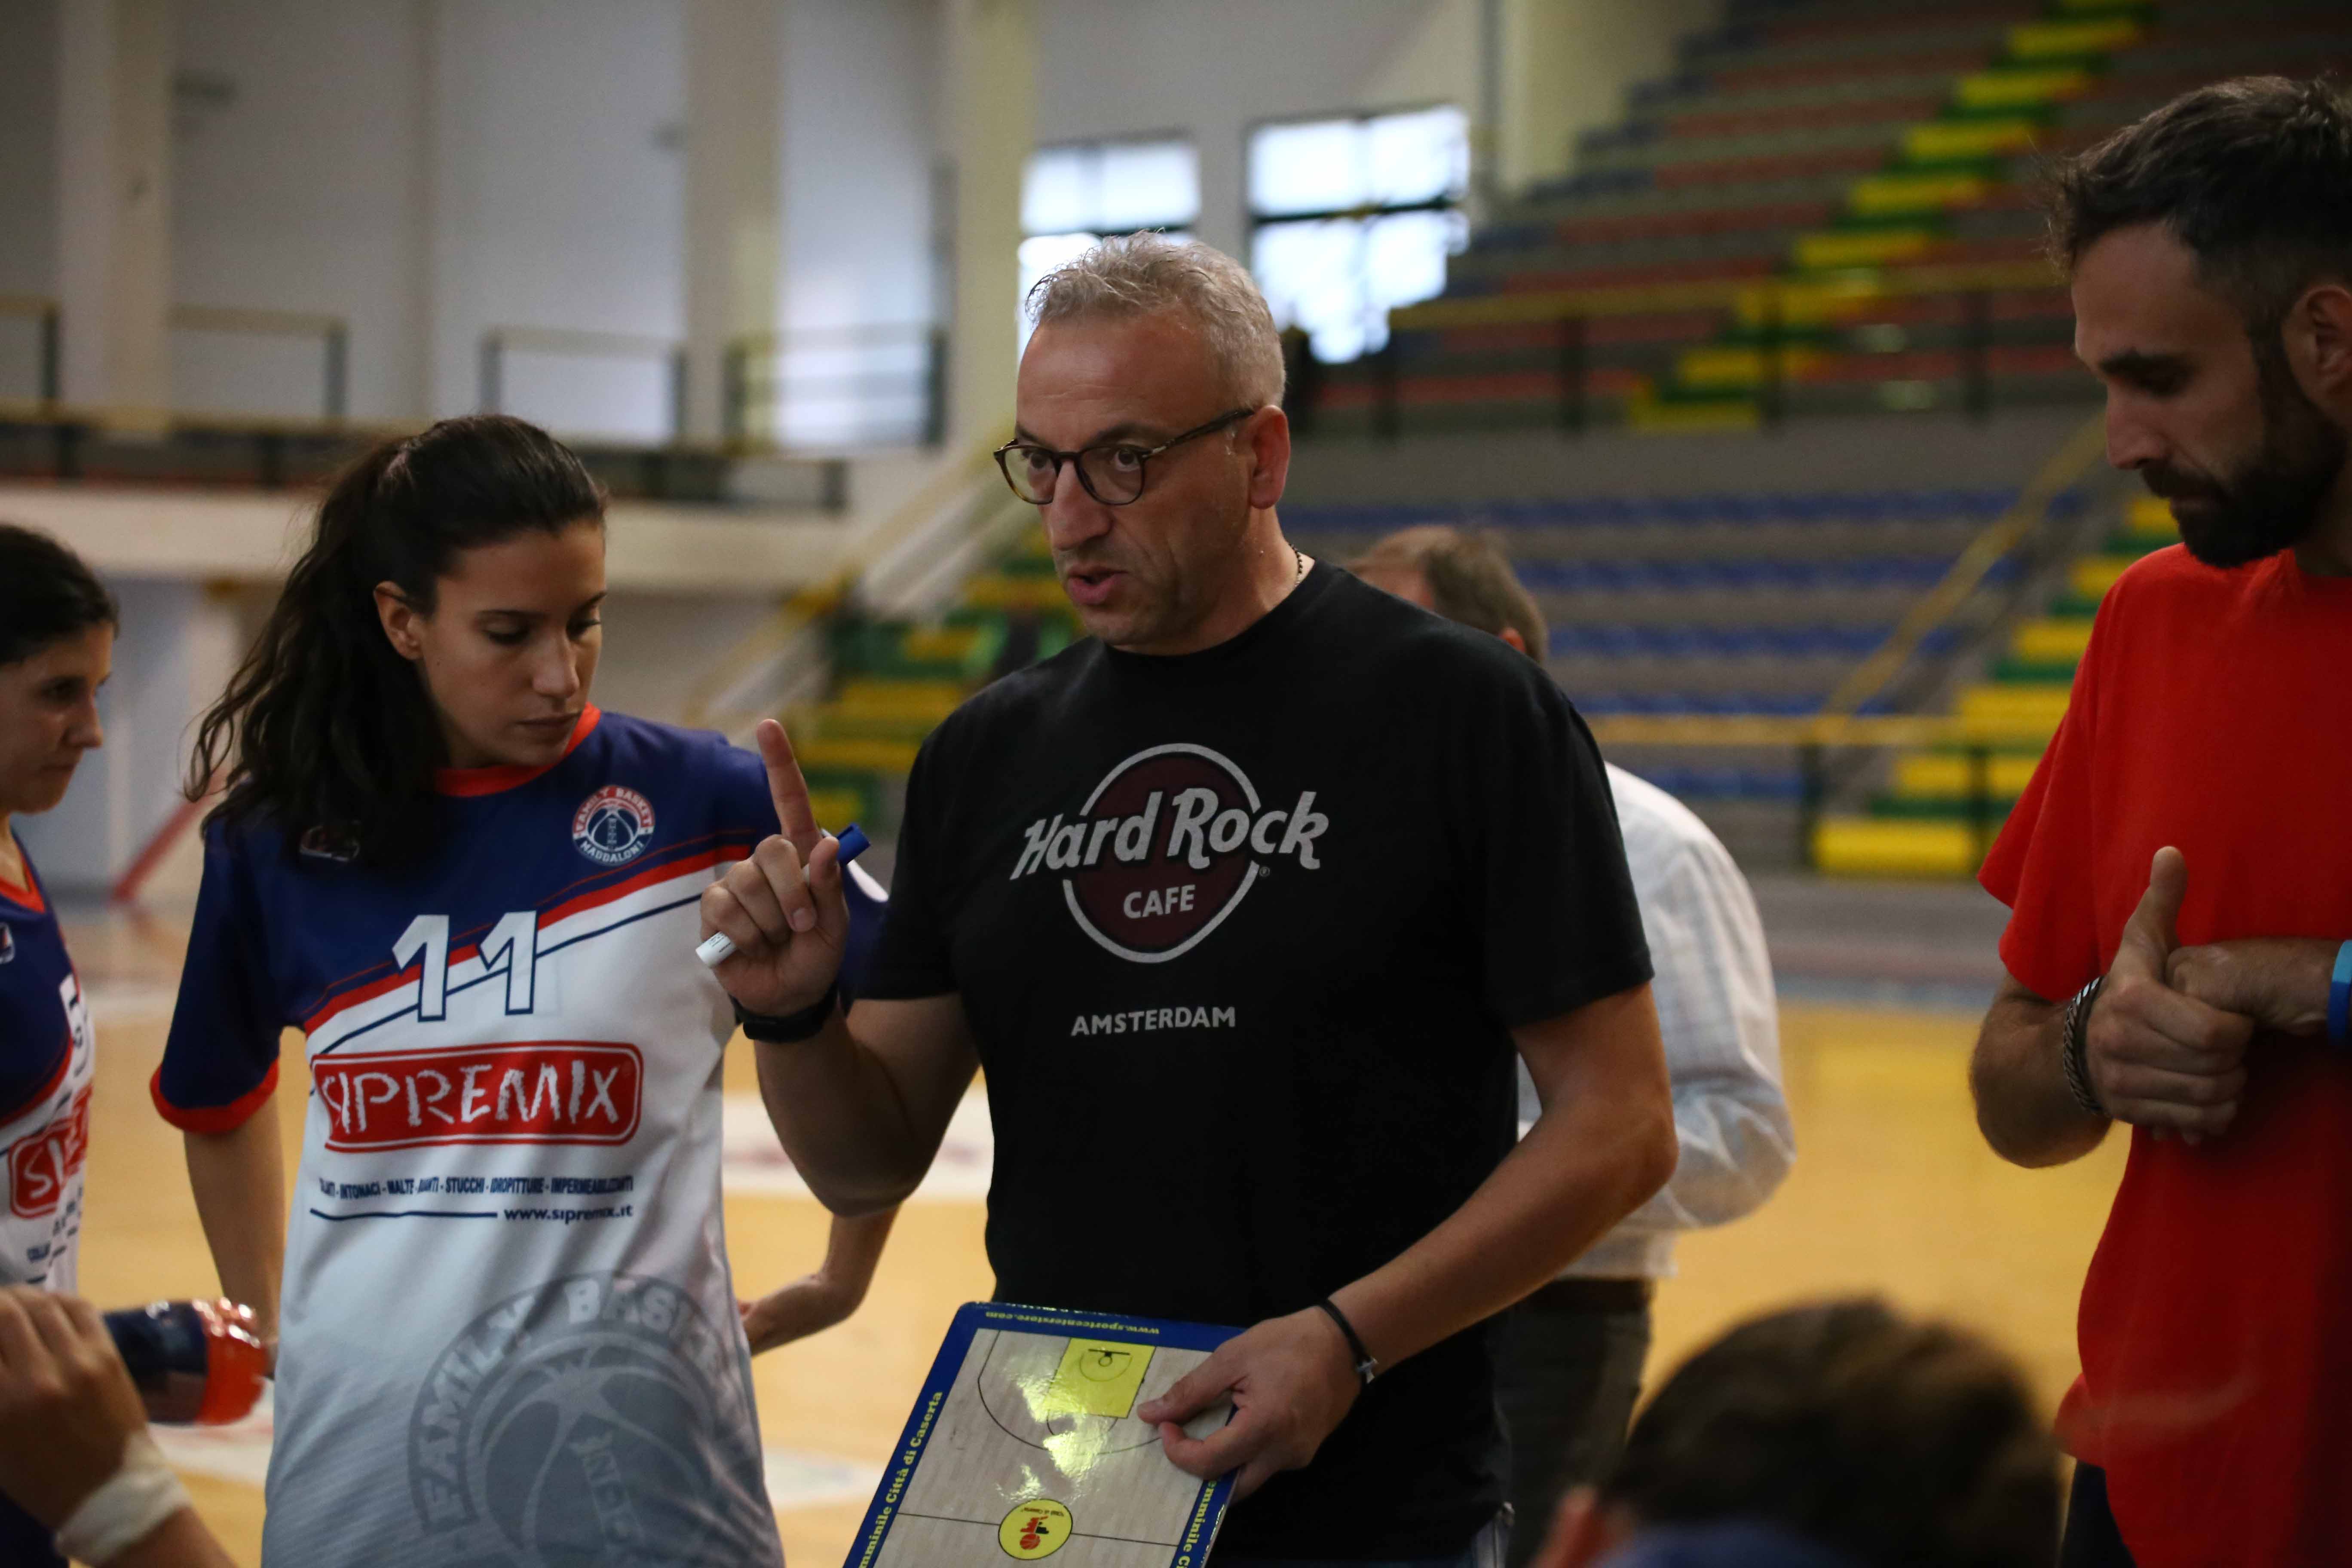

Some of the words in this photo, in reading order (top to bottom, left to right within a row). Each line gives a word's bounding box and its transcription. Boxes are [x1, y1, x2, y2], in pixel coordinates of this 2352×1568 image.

[616, 787, 652, 826] BASKET
[1010, 791, 1163, 880] Hard
[1167, 787, 1329, 870] Rock
[580, 840, 644, 863] MADDALONI
[1123, 884, 1196, 919] CAFE
[392, 910, 539, 1022] 11
[1071, 1006, 1236, 1037] AMSTERDAM
[322, 1060, 620, 1133] SIPREMIX
[445, 1176, 485, 1194] STUCCHI
[885, 1468, 910, 1504] Città
[903, 1450, 917, 1465] di
[910, 1391, 943, 1448] Caserta
[1183, 1480, 1217, 1553] emminile
